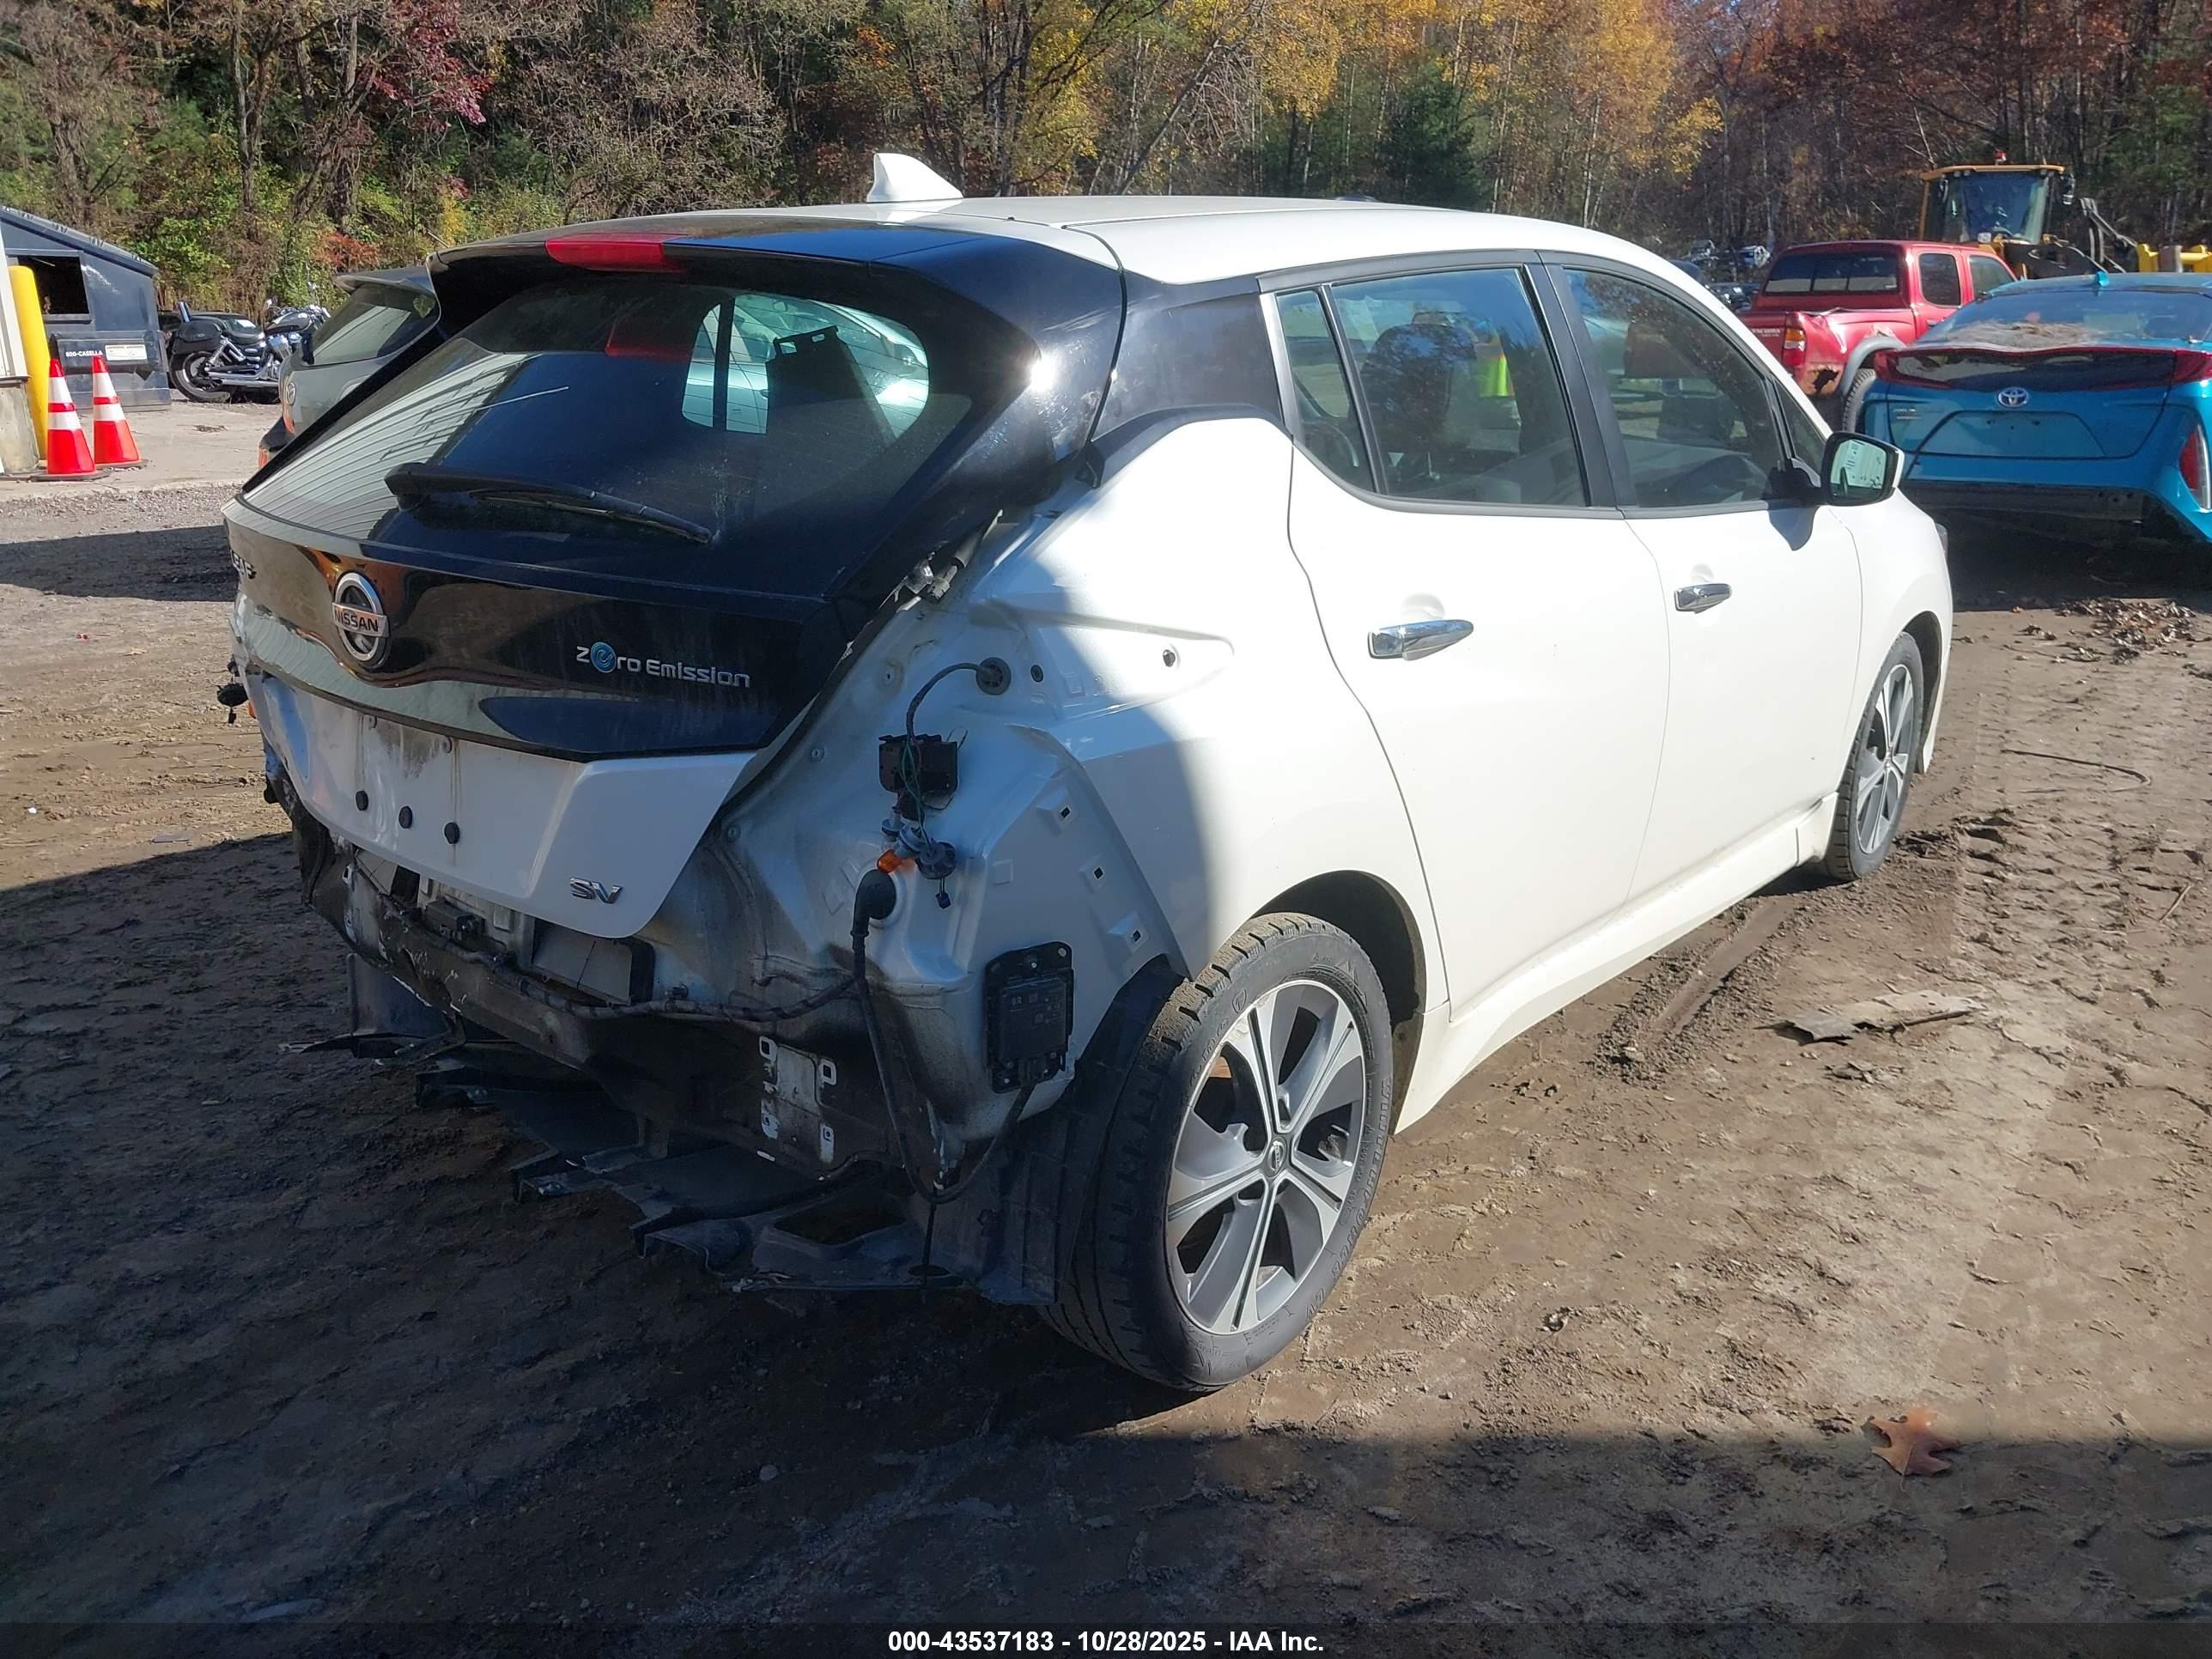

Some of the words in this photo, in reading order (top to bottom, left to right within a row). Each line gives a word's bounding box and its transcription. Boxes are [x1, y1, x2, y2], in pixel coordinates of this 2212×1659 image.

[334, 609, 379, 632] NISSAN
[646, 659, 750, 688] Emission
[569, 877, 623, 904] SV
